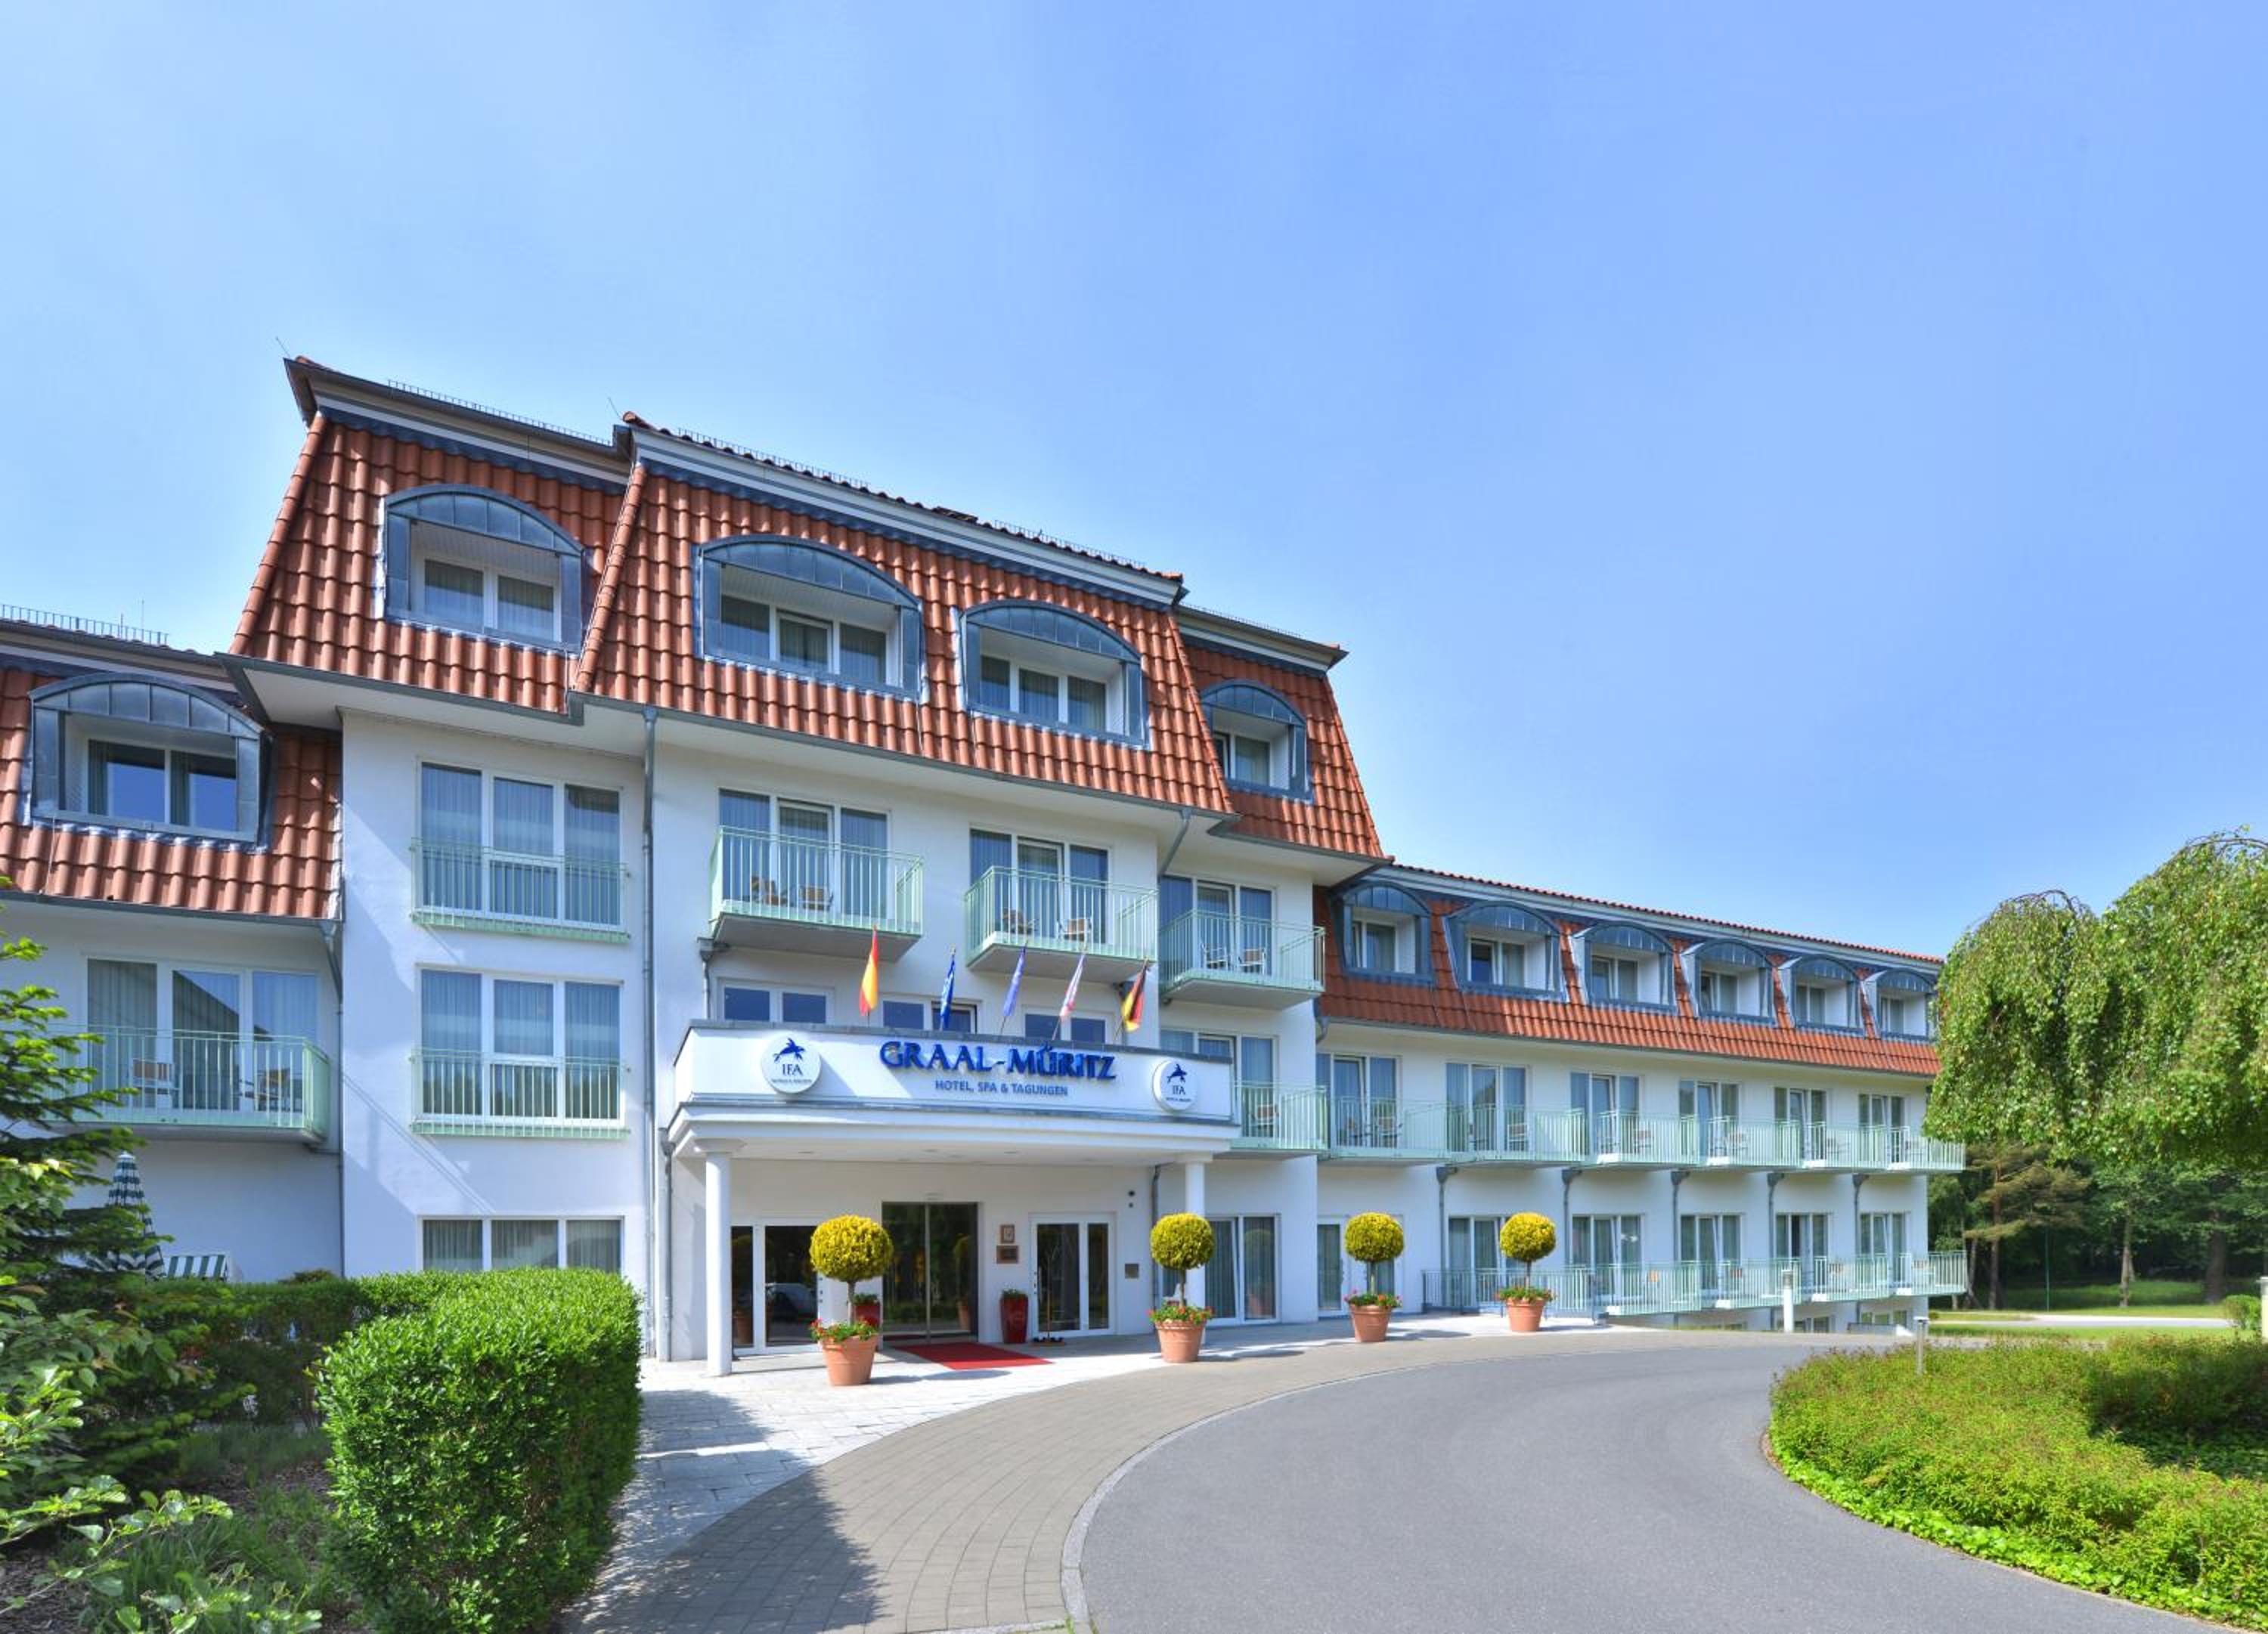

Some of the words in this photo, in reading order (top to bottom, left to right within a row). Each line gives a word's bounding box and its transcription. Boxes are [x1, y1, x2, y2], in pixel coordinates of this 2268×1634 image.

[879, 1040, 1117, 1080] GRAAL-MÜRITZ
[782, 1063, 804, 1075] IFA
[935, 1080, 974, 1093] HOTEL,
[978, 1082, 997, 1094] SPA
[1000, 1083, 1009, 1094] &
[1011, 1083, 1068, 1096] TAGUNGEN
